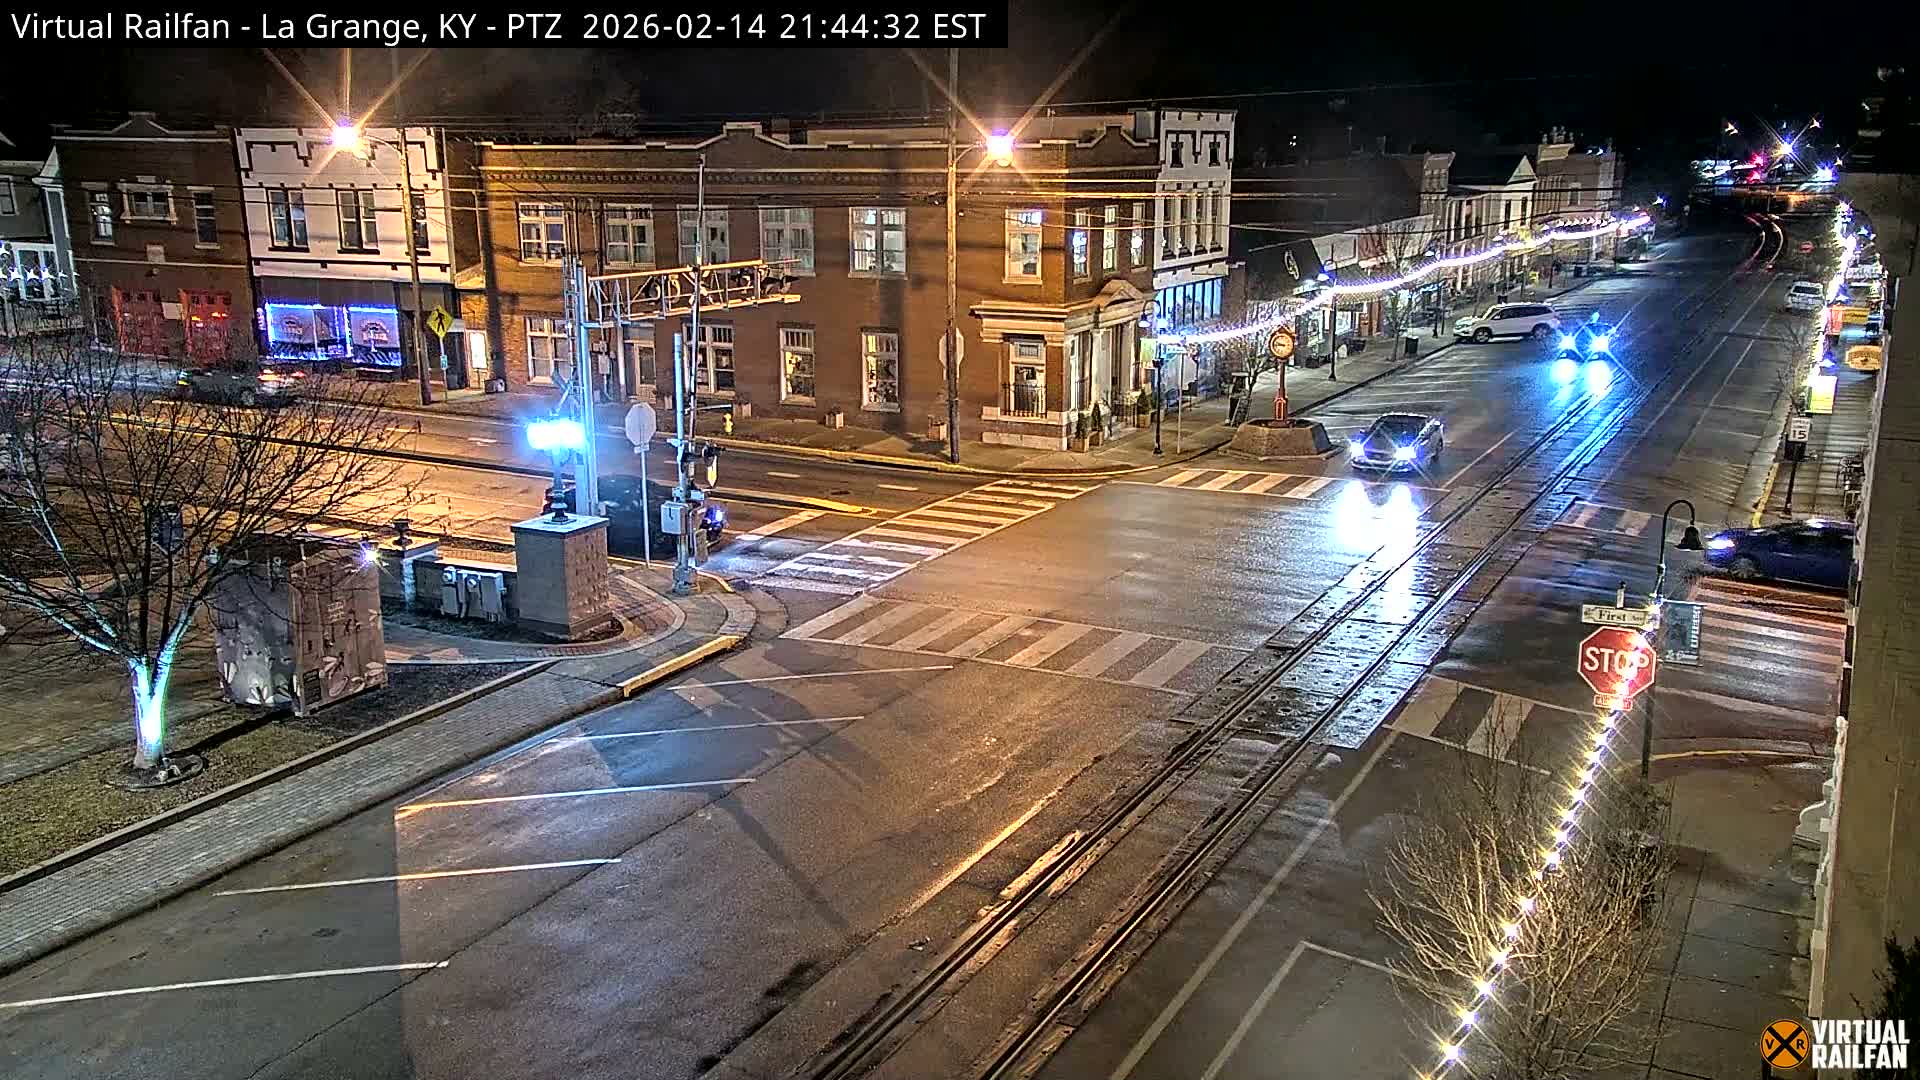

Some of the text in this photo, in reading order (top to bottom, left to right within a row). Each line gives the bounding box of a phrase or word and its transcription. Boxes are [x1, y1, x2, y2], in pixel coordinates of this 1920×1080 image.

[1792, 430, 1807, 440] 15
[1599, 609, 1626, 622] First
[1583, 646, 1650, 676] STOP
